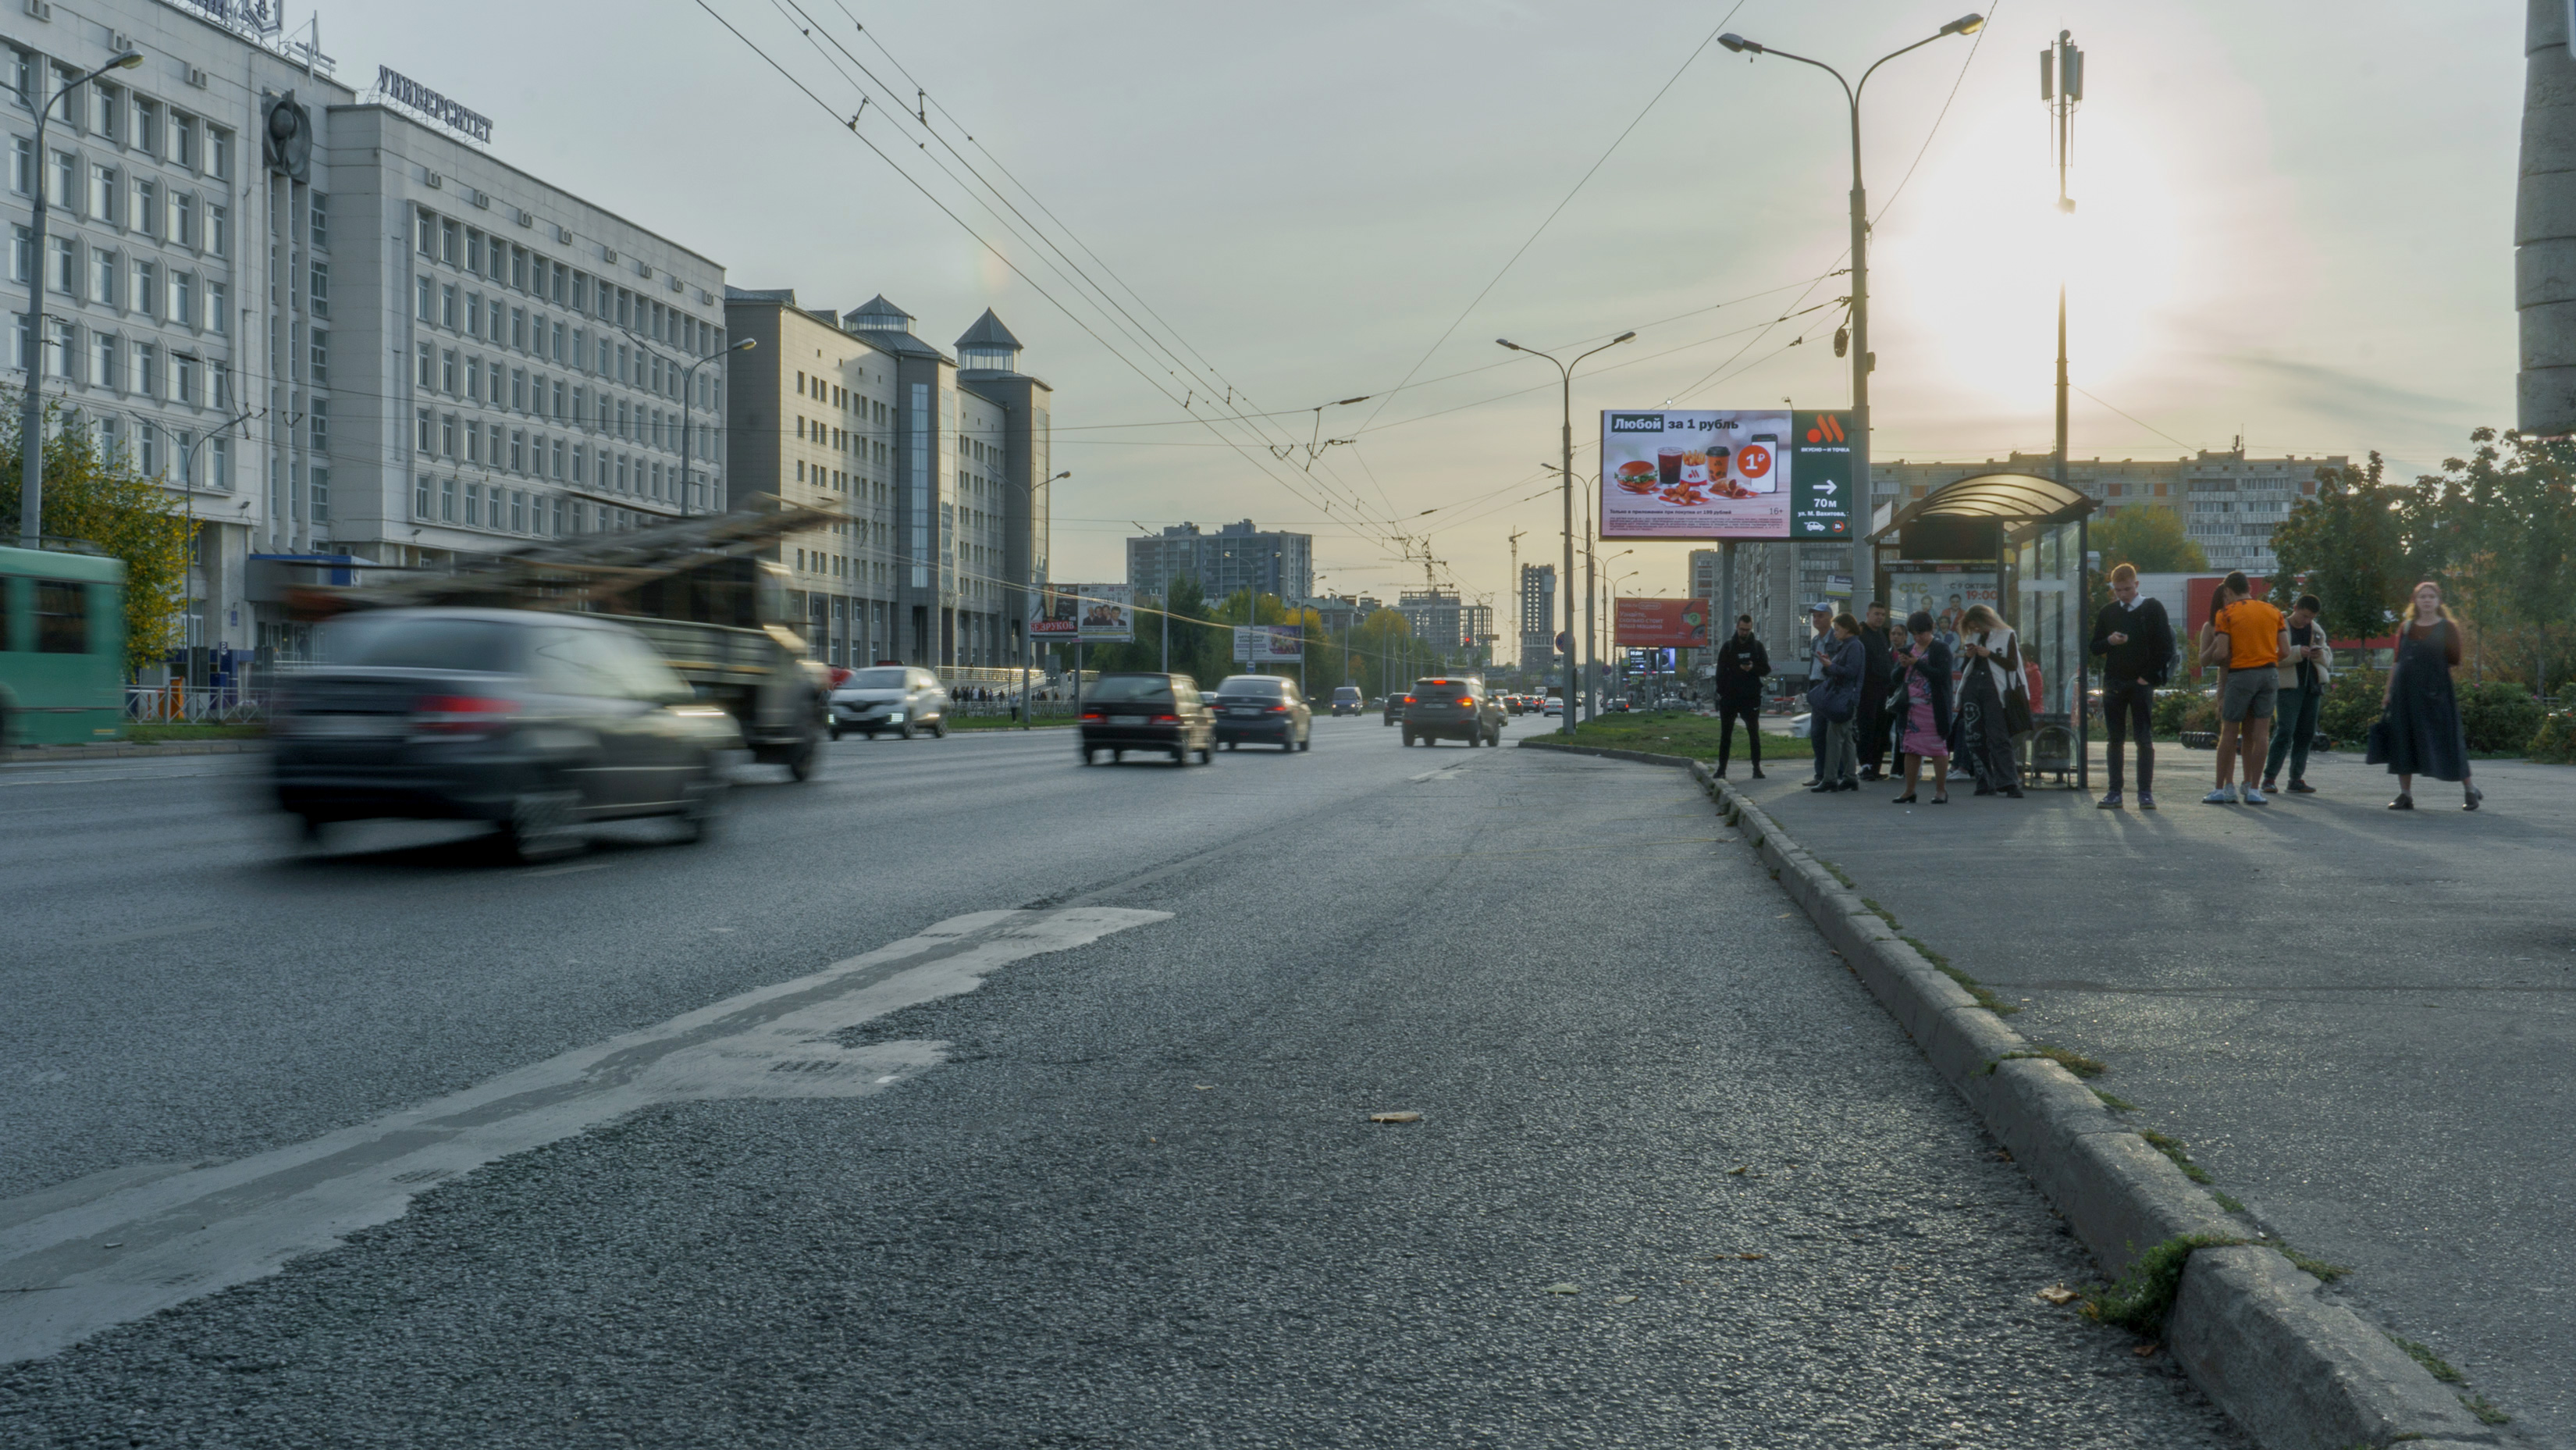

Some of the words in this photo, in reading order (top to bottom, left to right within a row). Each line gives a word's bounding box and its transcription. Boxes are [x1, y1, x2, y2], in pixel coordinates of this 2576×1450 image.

[379, 64, 493, 144] УНИВЕРСИТЕТ
[1614, 418, 1661, 429] Любой
[1668, 421, 1683, 429] за
[1688, 419, 1695, 429] 1
[1699, 419, 1739, 431] рубль
[1898, 582, 1928, 594] СТС
[1966, 590, 1998, 600] 19:00
[1030, 621, 1074, 632] БЕЗРУКОВ
